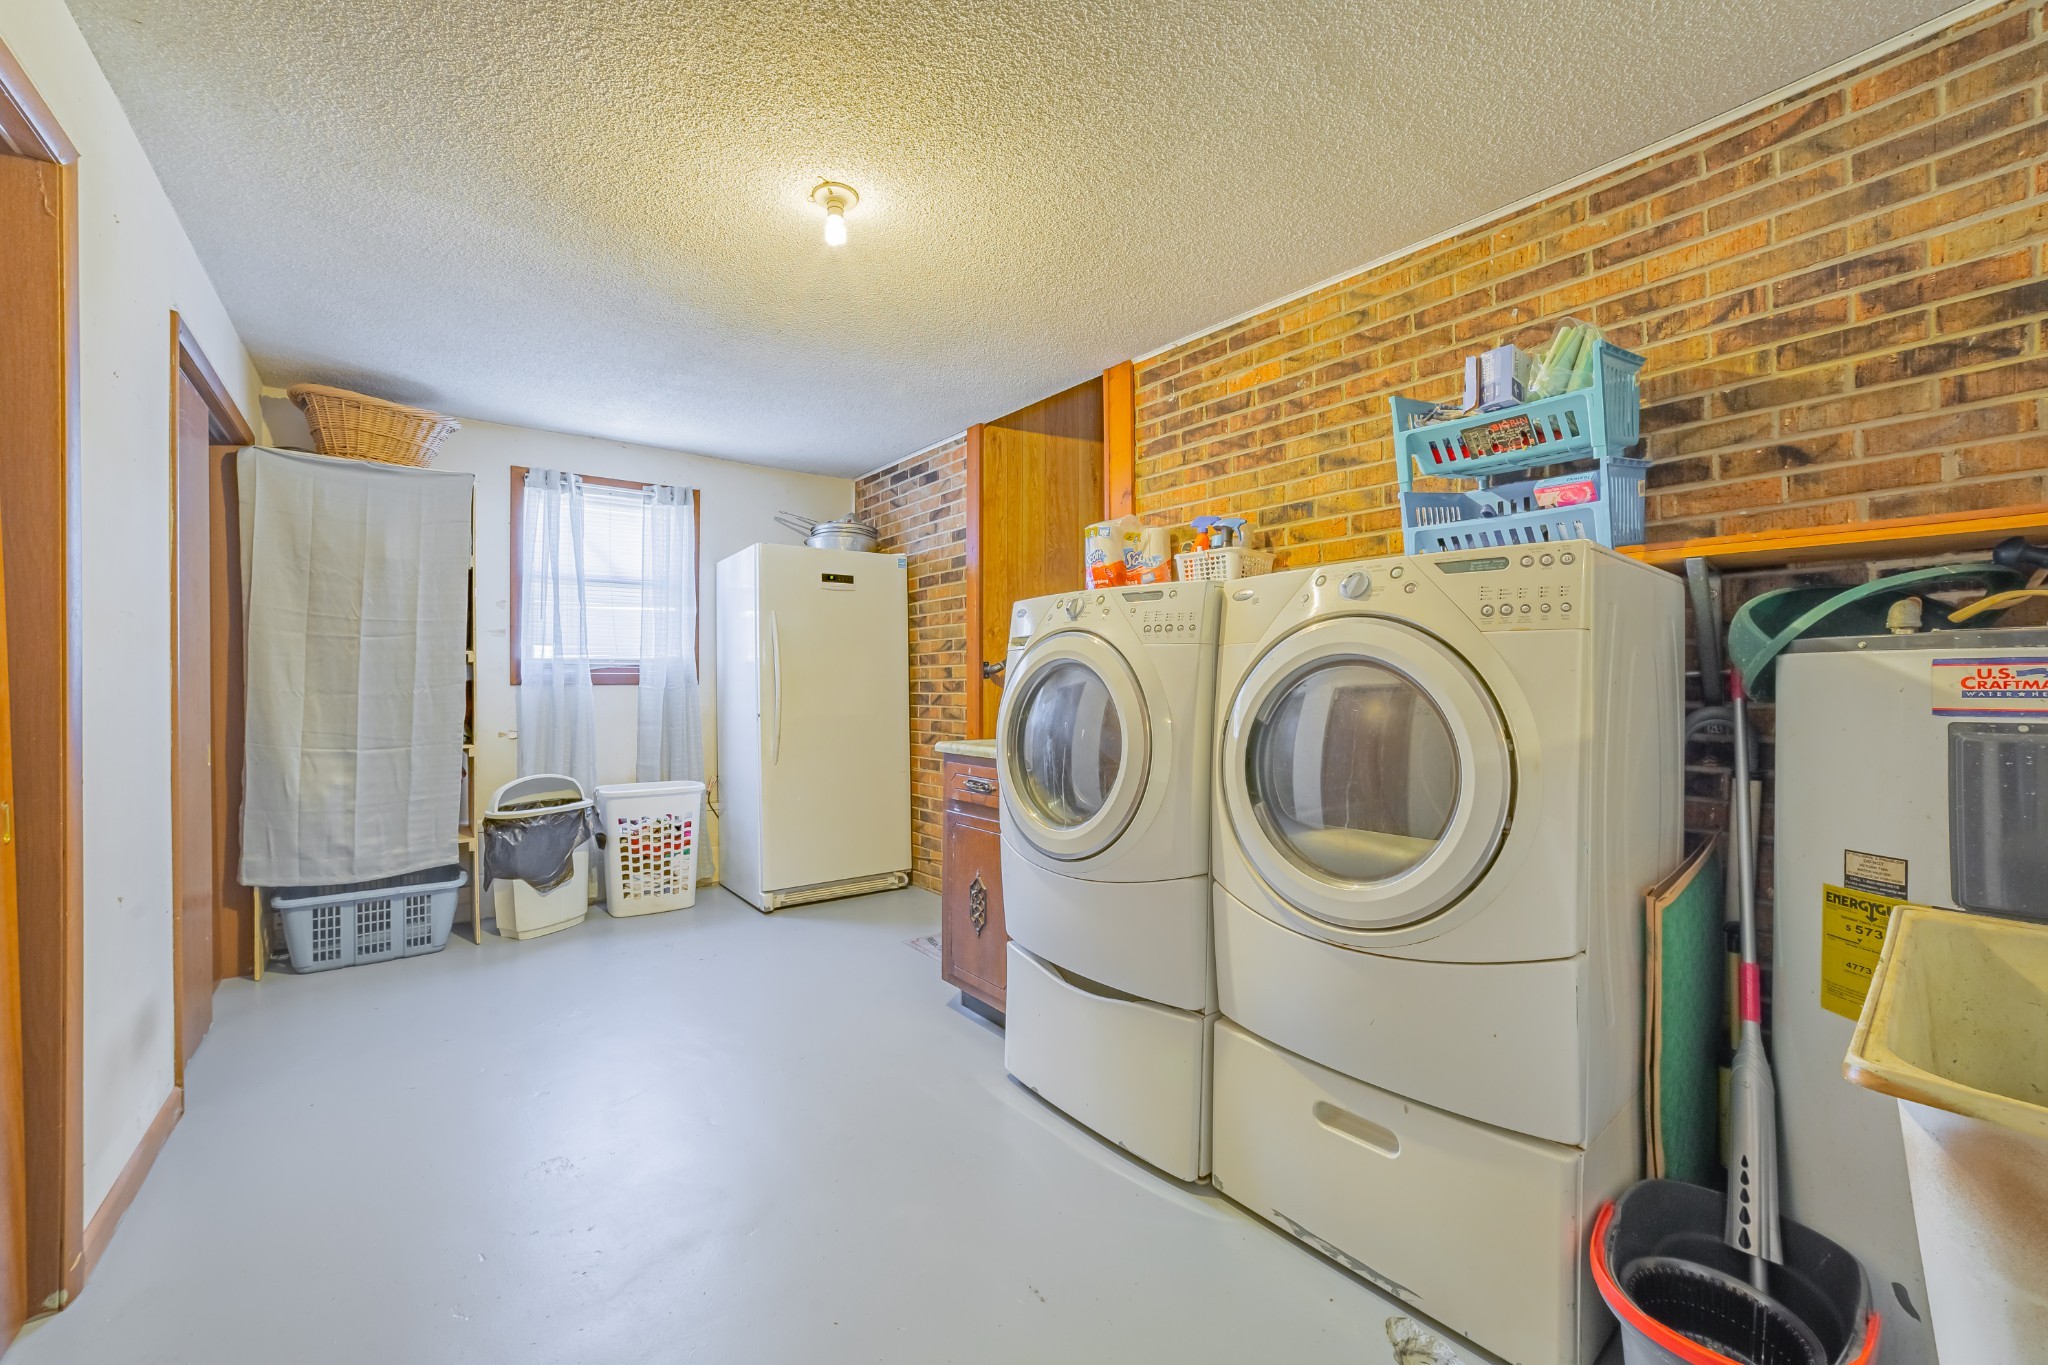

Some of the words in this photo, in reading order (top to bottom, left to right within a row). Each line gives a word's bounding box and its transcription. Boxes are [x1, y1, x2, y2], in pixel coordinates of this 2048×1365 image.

[1976, 668, 2016, 680] U.S.
[1855, 925, 1883, 940] 573
[1846, 962, 1872, 974] 4773
